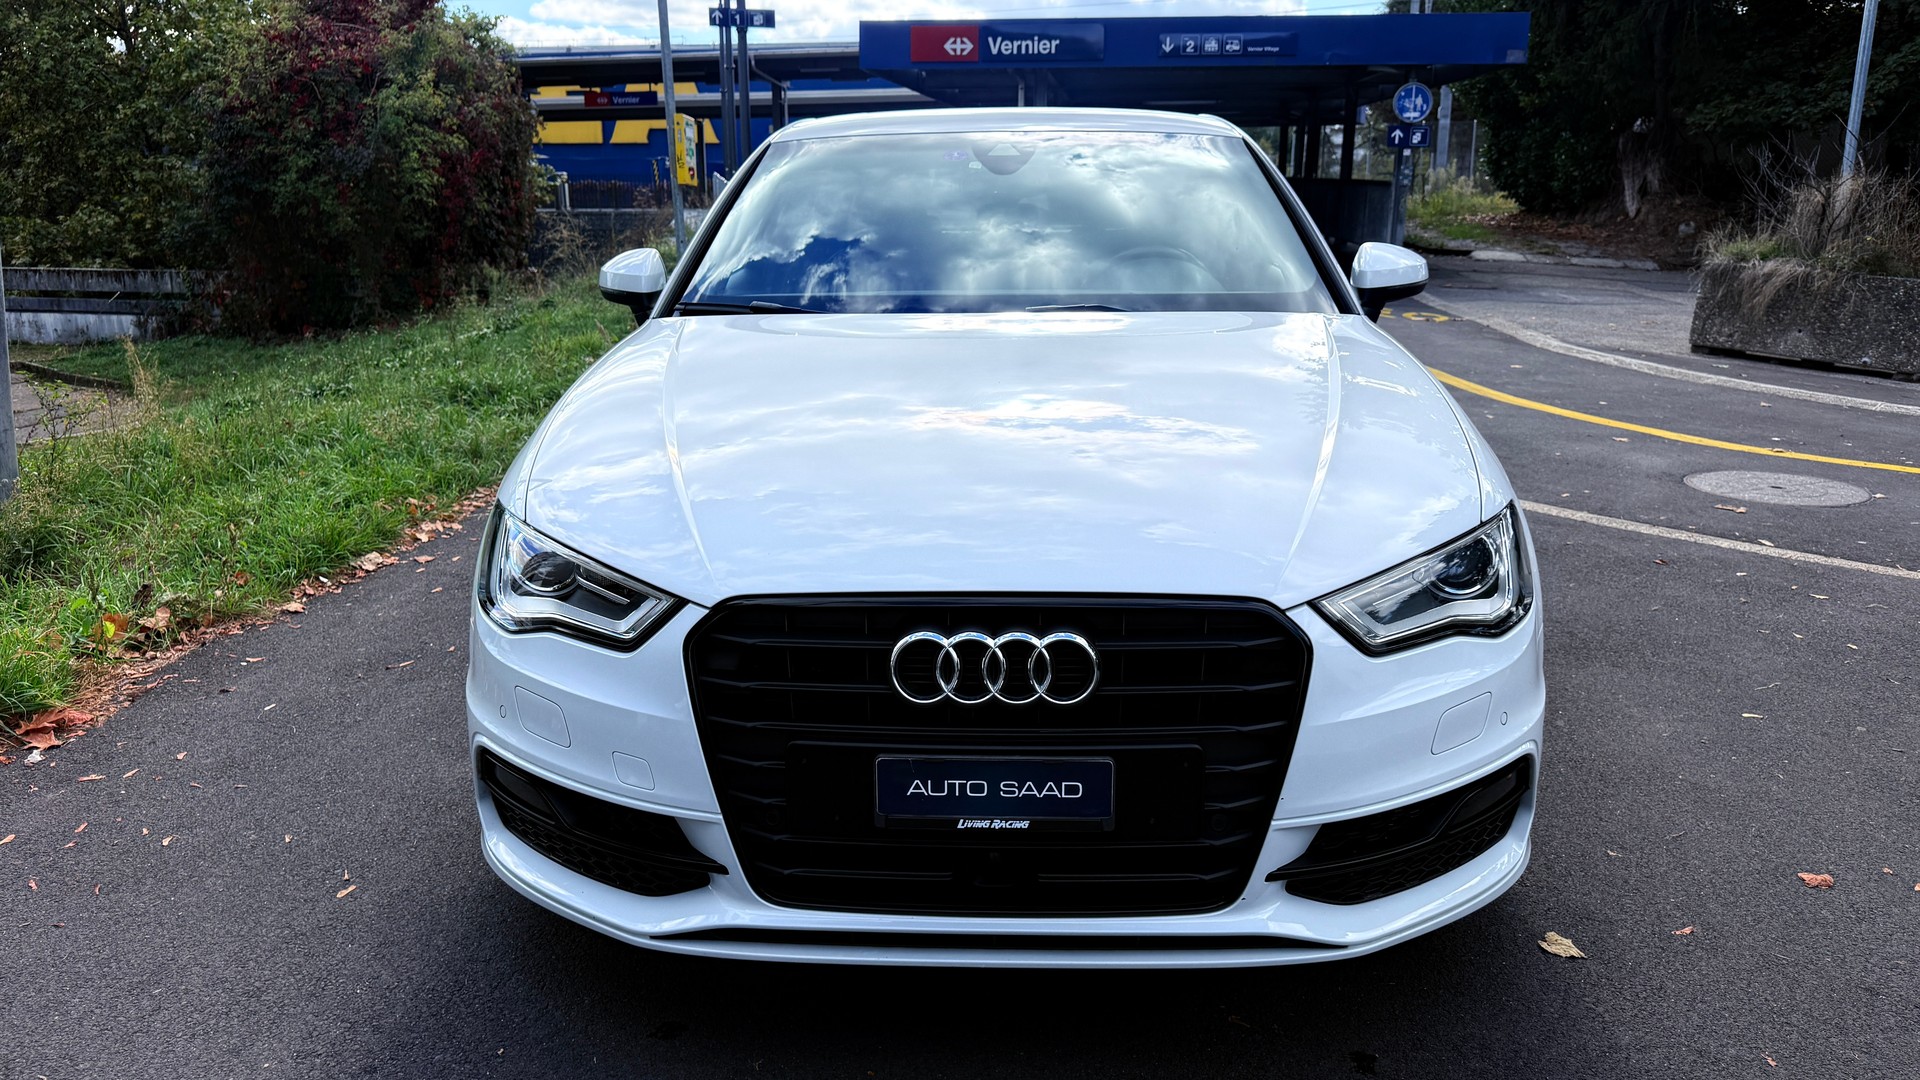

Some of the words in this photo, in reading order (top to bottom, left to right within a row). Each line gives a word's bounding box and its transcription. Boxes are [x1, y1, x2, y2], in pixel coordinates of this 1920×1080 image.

[987, 35, 1061, 55] Vernier
[1185, 39, 1195, 53] 2
[612, 96, 640, 105] Vernier
[906, 779, 988, 797] AUTO
[1000, 781, 1083, 799] SAAD
